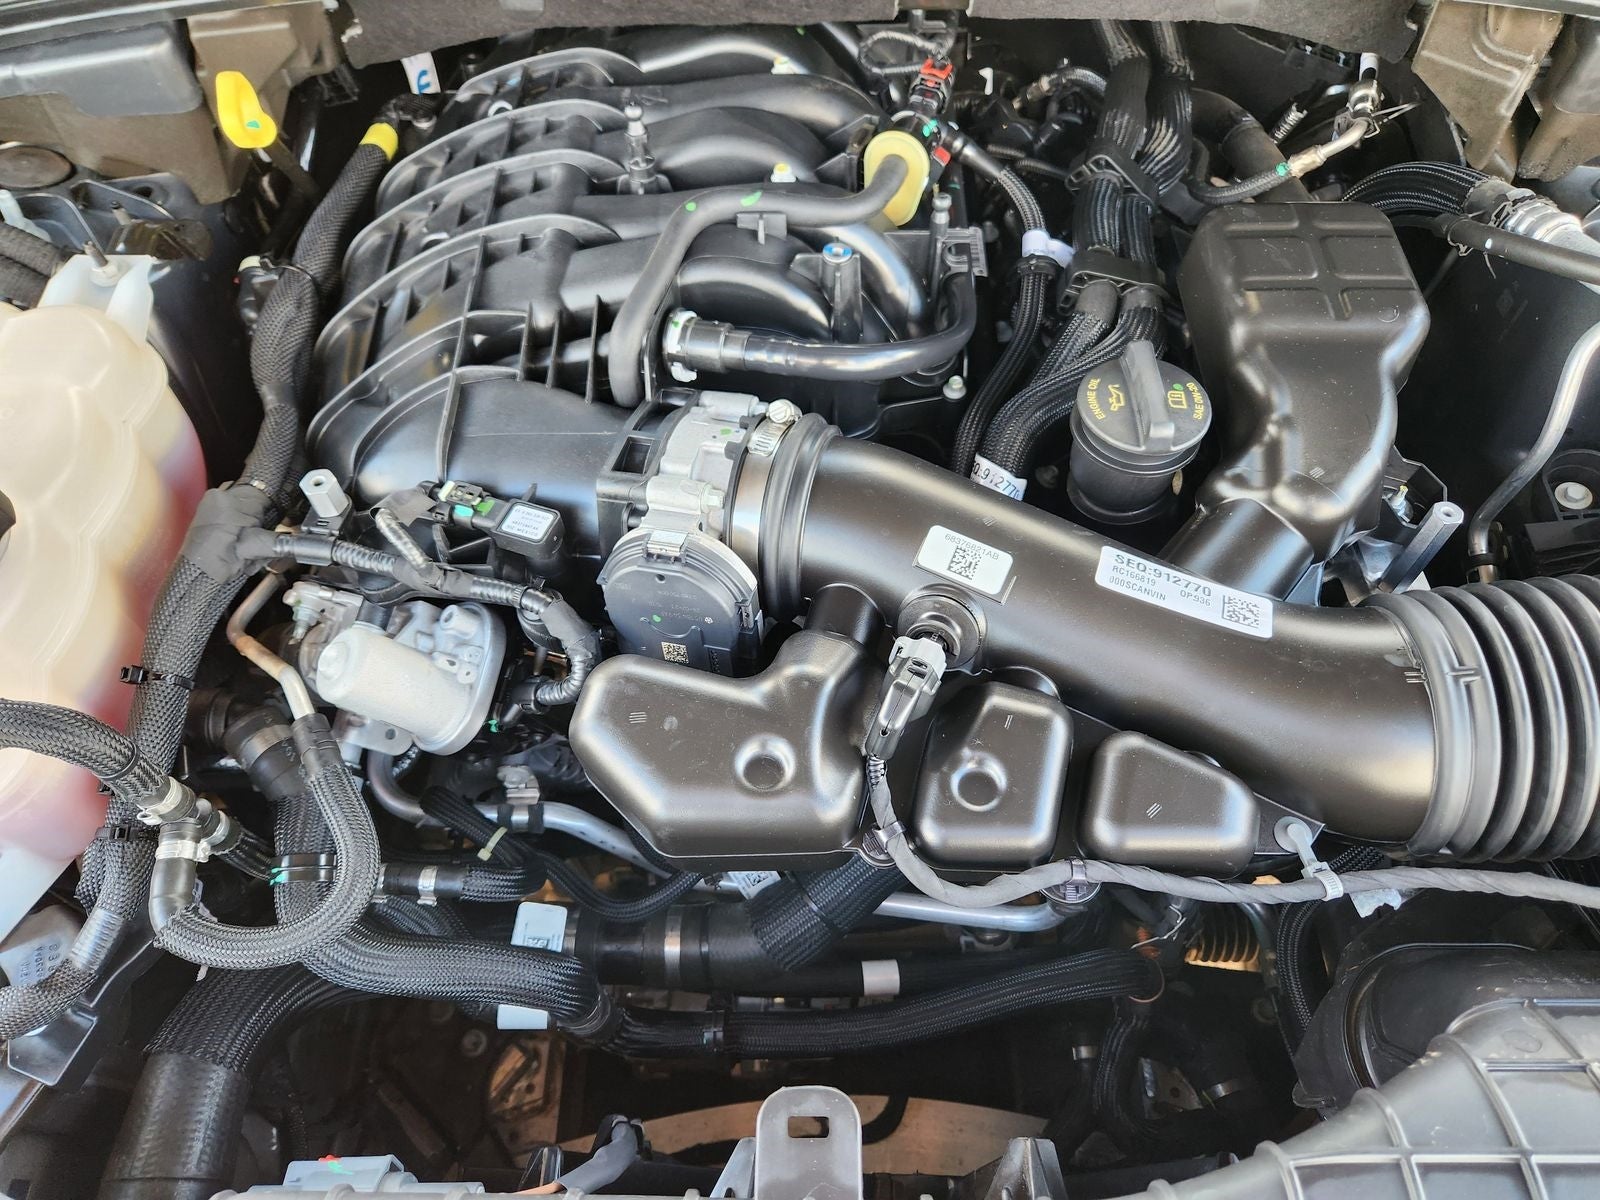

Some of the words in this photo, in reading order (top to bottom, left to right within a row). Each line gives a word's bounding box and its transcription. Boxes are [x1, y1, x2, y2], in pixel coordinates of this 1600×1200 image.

[1088, 378, 1101, 390] OIL
[1087, 391, 1106, 420] ENGINE
[1193, 404, 1204, 420] SAE
[944, 533, 999, 560] 68376821AB
